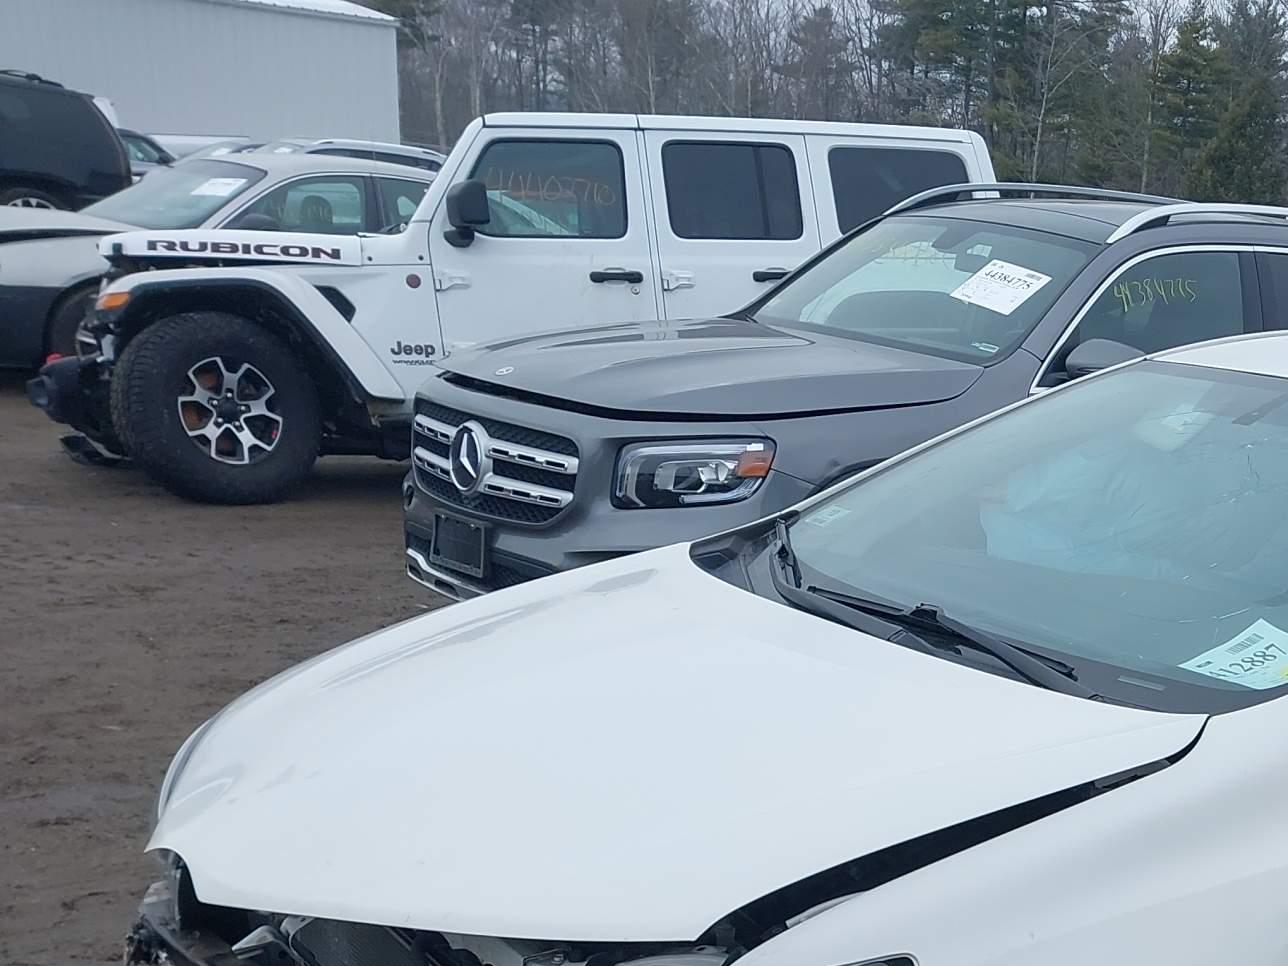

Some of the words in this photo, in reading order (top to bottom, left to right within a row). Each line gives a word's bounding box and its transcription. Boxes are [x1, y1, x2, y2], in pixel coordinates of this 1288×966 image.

[147, 240, 341, 260] RUBICON
[984, 269, 1033, 290] 44384775
[390, 340, 436, 358] Jeep
